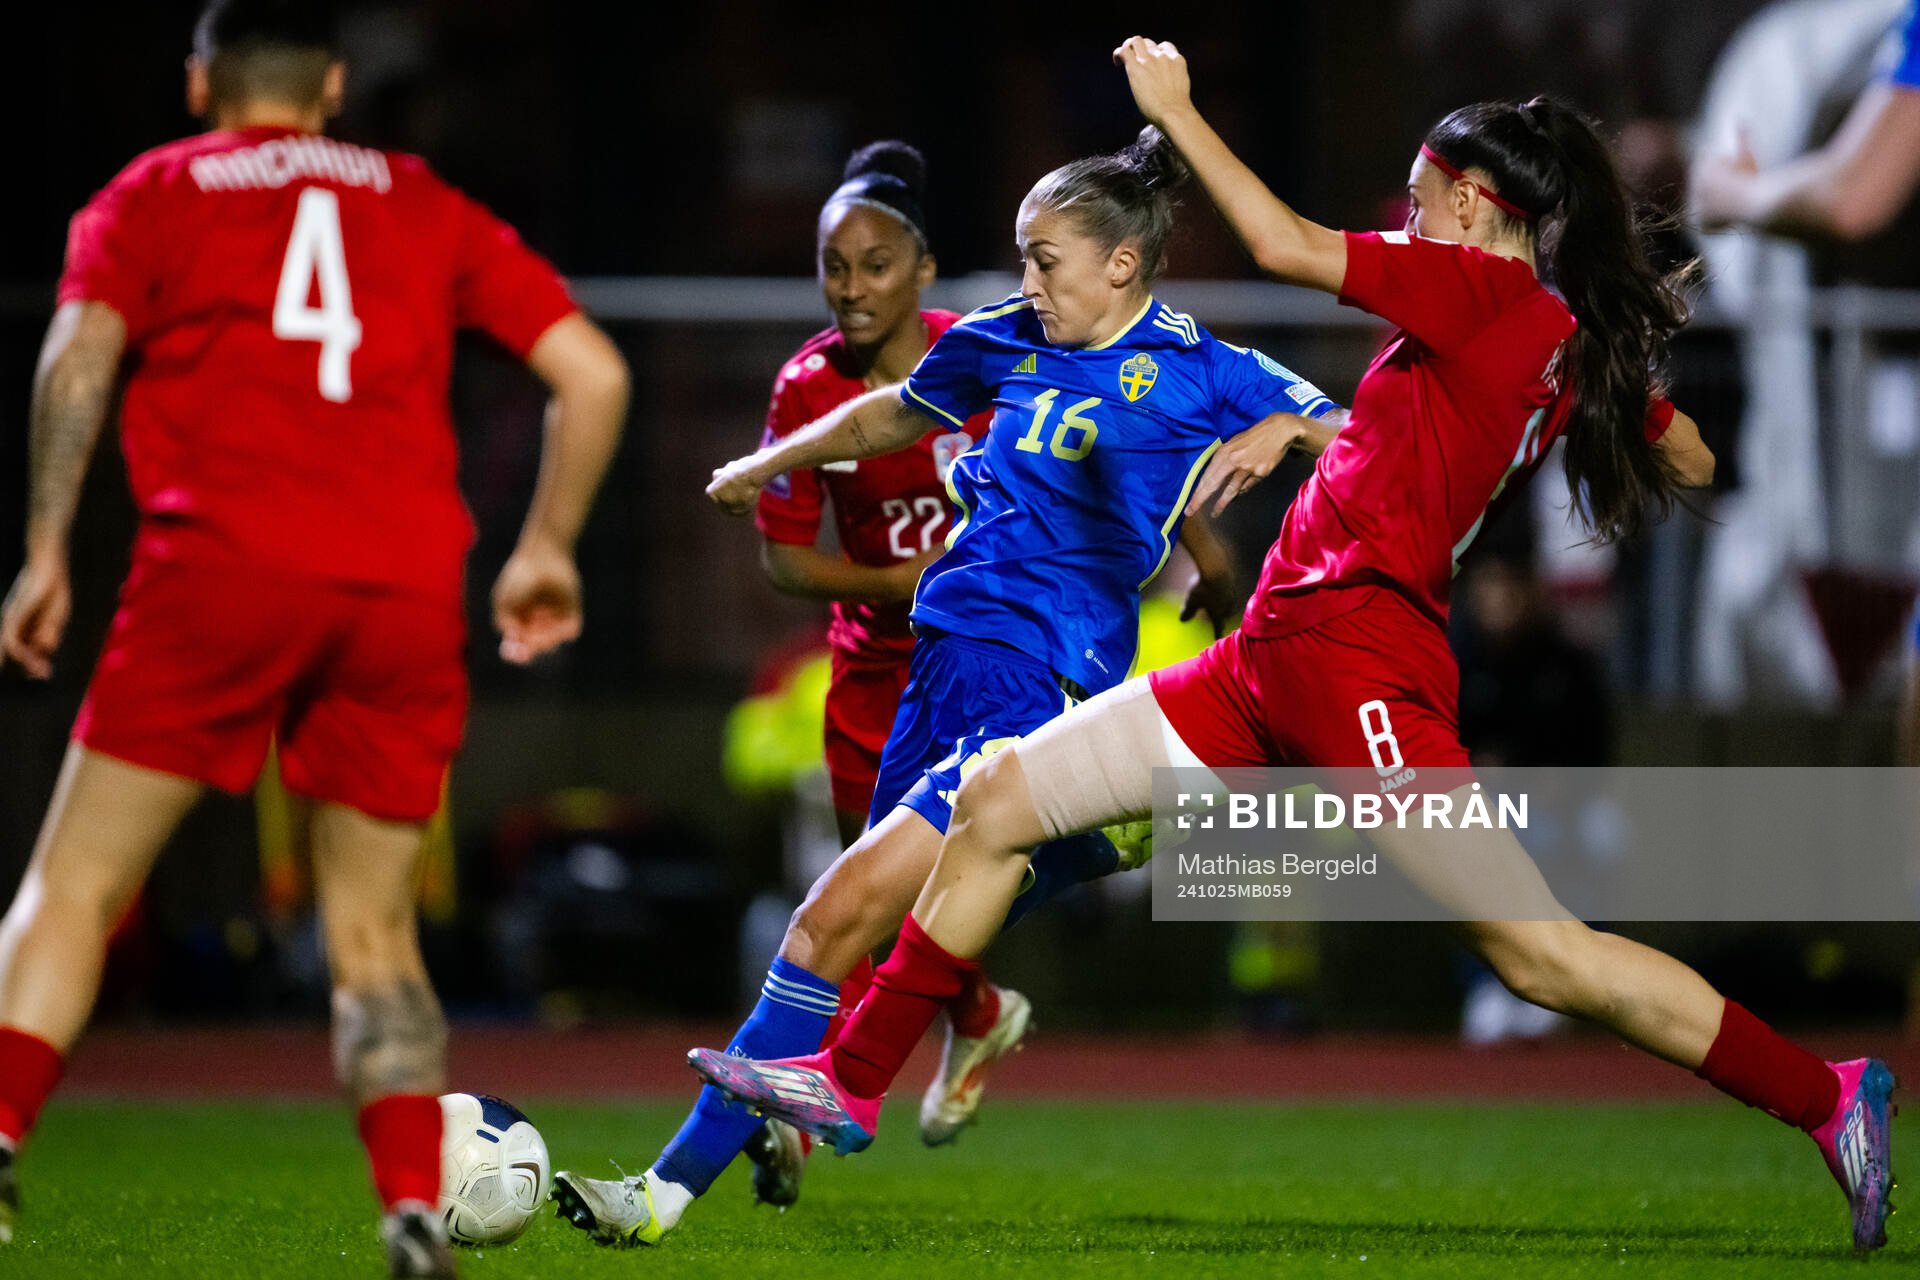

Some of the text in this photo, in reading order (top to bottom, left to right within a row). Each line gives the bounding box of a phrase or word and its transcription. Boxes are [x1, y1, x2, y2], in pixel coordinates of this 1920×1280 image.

[273, 186, 363, 403] 4
[1015, 388, 1103, 462] 16
[882, 497, 946, 557] 22
[1358, 700, 1404, 777] 8
[1380, 768, 1416, 793] JAKO
